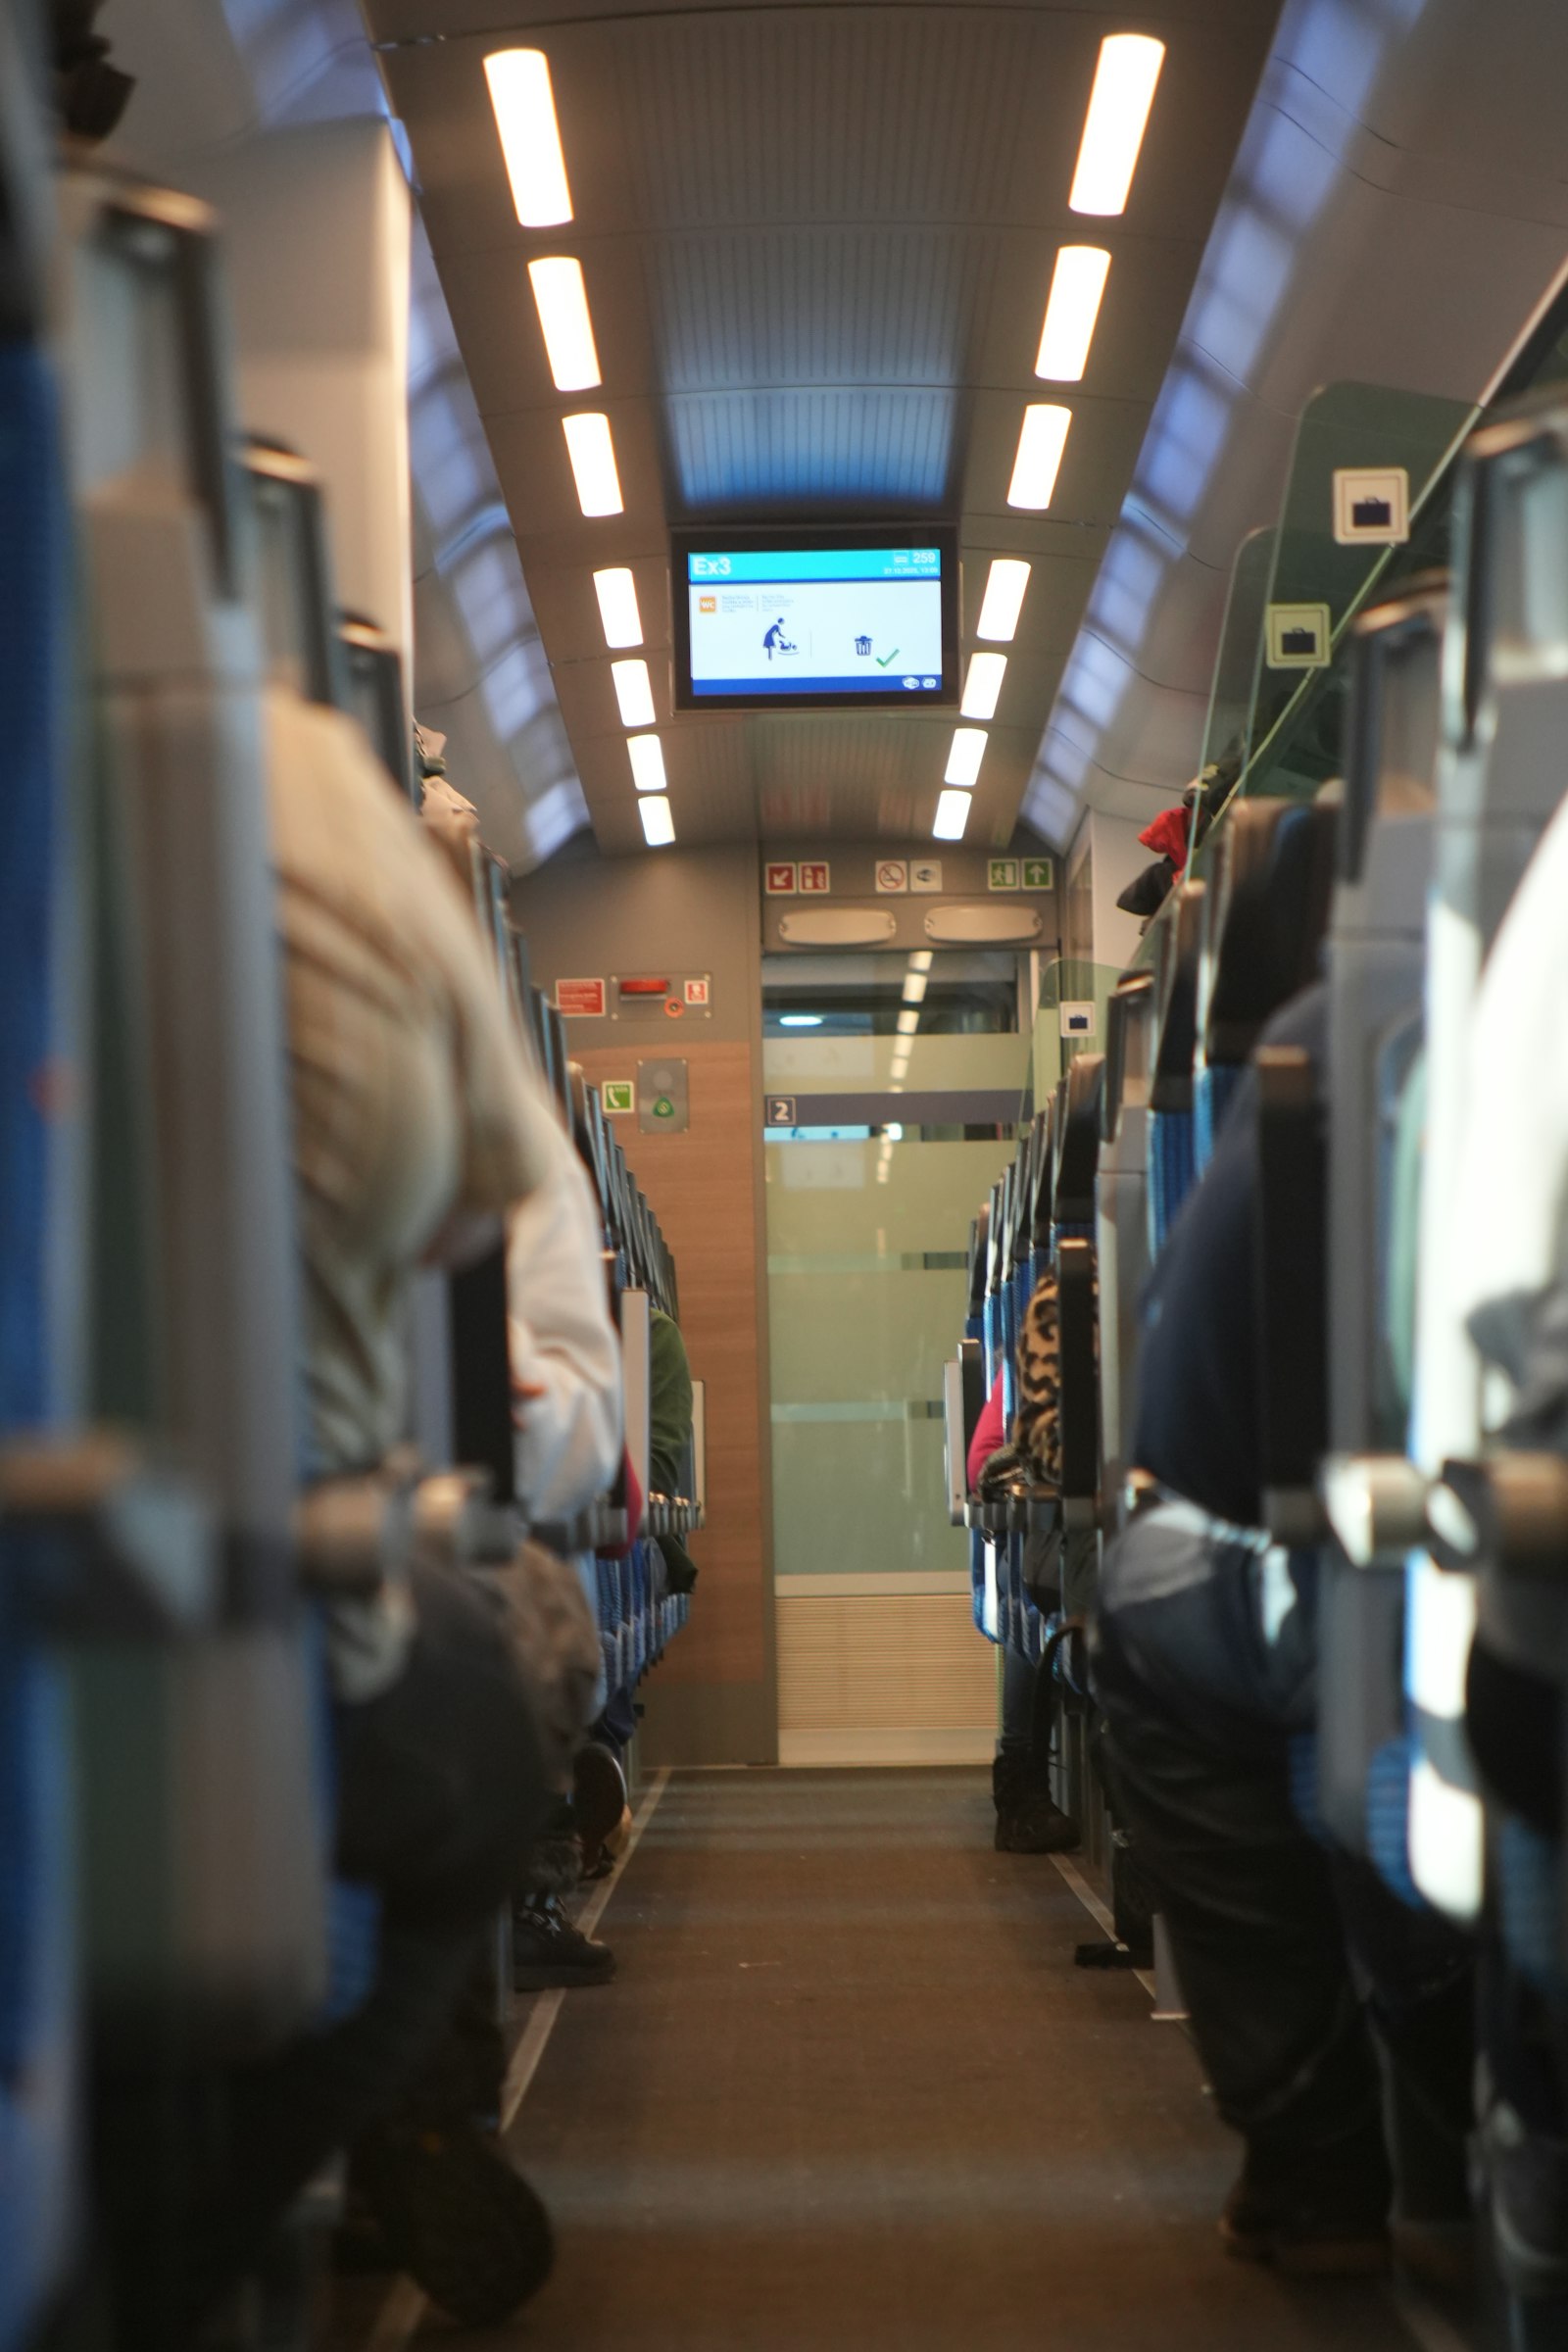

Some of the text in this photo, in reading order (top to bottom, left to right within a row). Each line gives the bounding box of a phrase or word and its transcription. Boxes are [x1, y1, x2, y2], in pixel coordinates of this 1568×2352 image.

[693, 556, 731, 575] Ex3
[912, 552, 936, 564] 259
[701, 601, 716, 611] WC
[774, 1102, 789, 1121] 2
